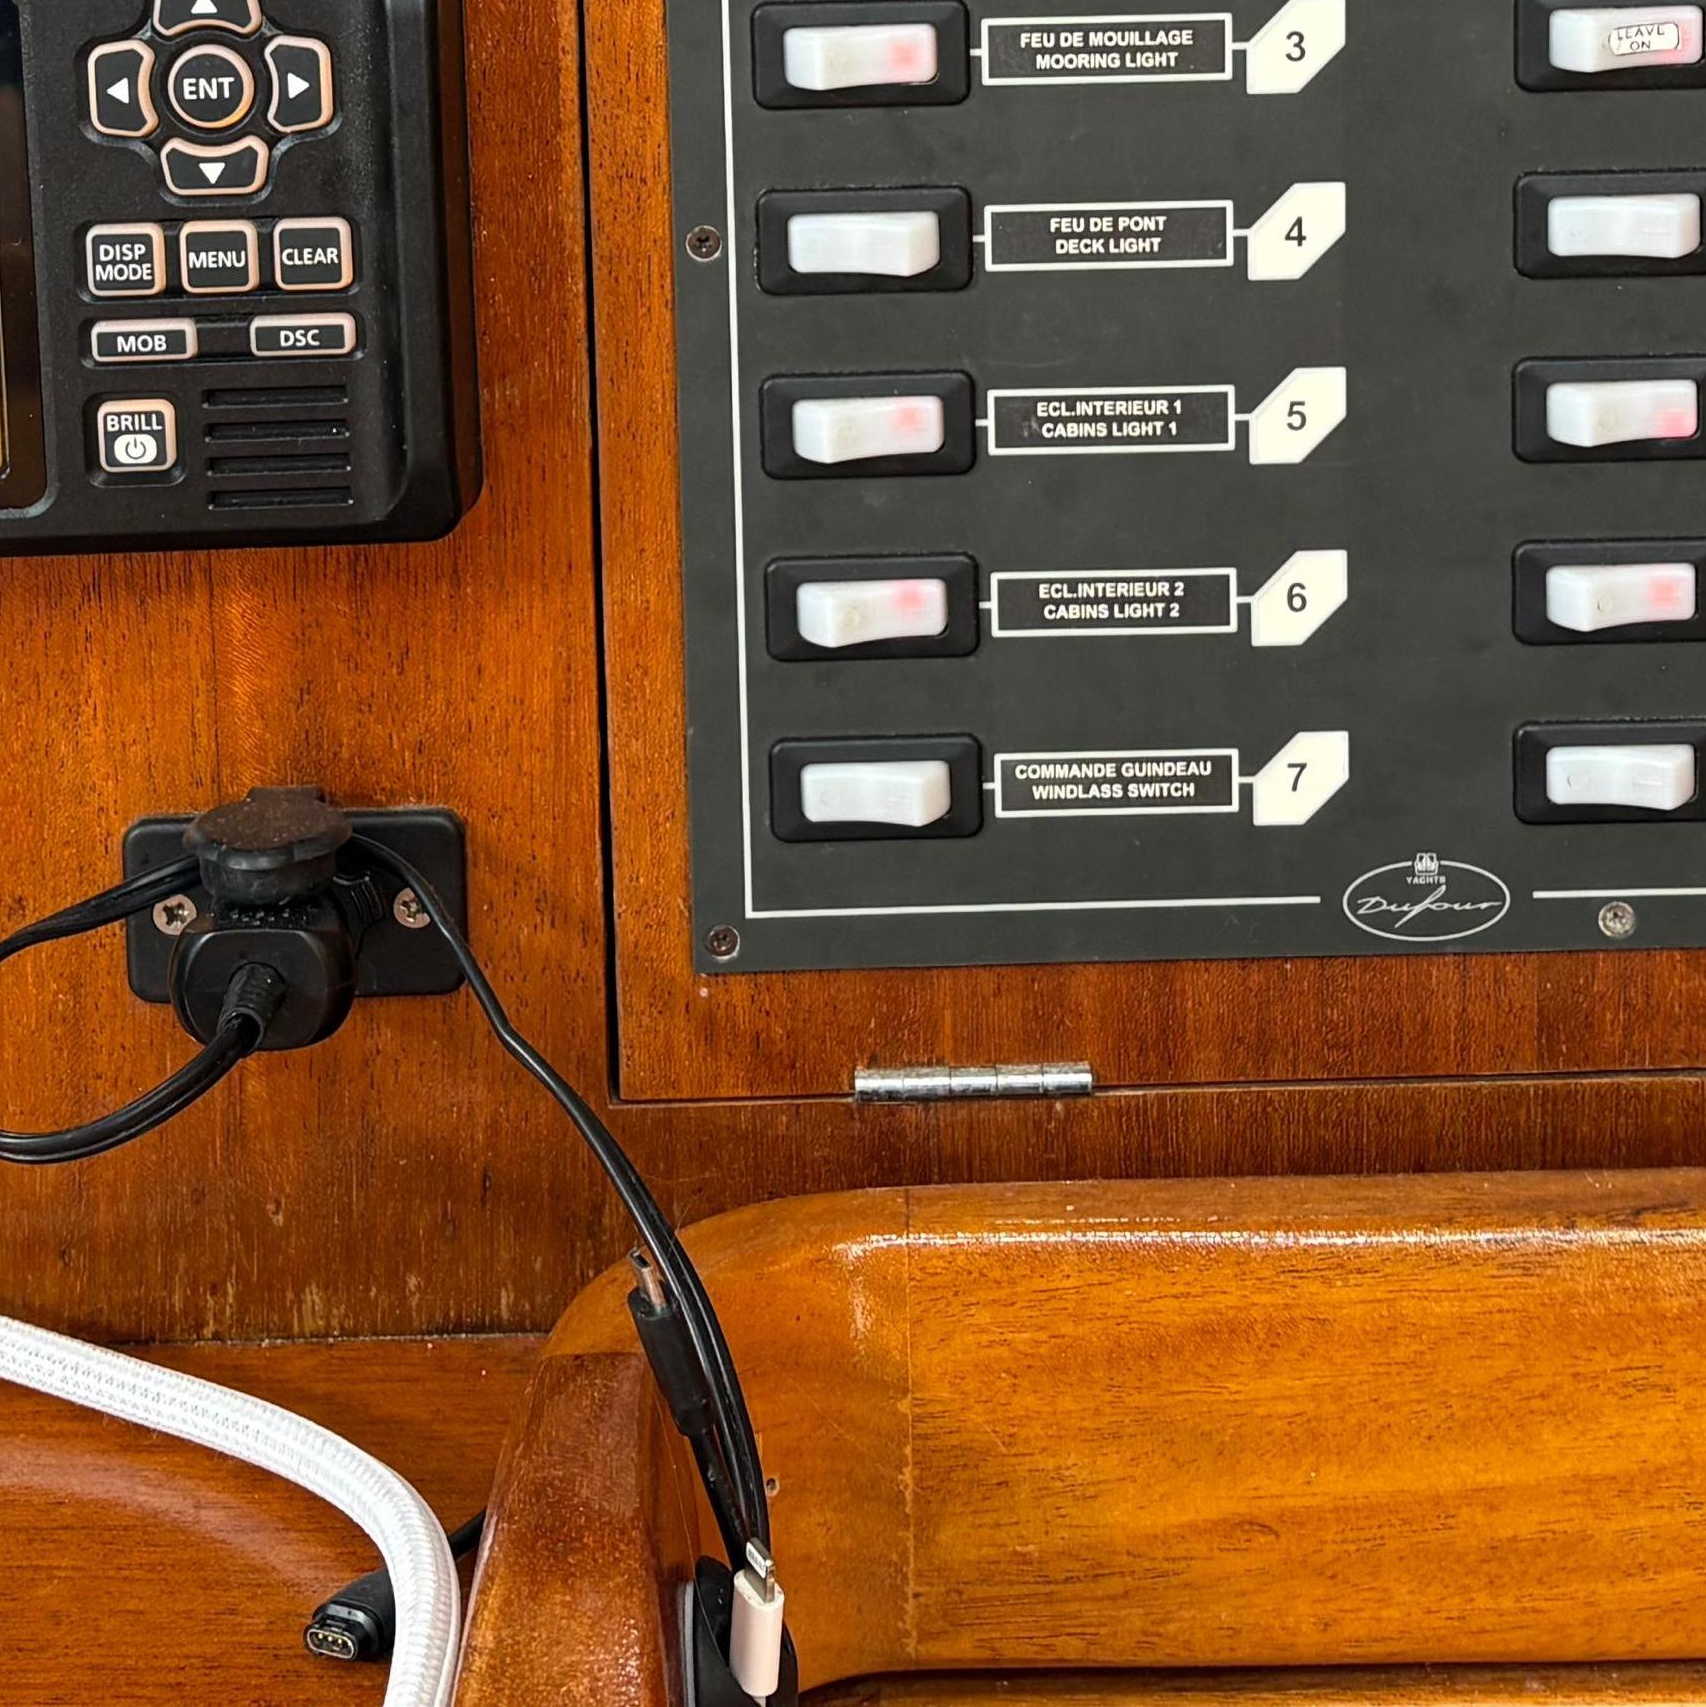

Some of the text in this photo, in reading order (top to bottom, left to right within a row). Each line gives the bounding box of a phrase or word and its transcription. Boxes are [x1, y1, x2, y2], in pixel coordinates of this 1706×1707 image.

[1019, 29, 1193, 48] FEU DE MOUILLAGE
[1284, 31, 1307, 61] 3
[183, 77, 235, 100] ENT
[1283, 216, 1307, 246] 4
[99, 244, 145, 262] DISP
[1055, 236, 1161, 255] DECK LIGHT
[189, 250, 245, 268] MENU
[282, 248, 339, 265] CLEAR
[95, 263, 153, 281] MODE
[117, 335, 167, 353] MOB
[280, 329, 320, 346] DSC
[107, 414, 162, 432] BRILL
[1285, 401, 1307, 431] 5
[1285, 582, 1308, 612] 6
[1015, 759, 1212, 779] COMMANDE GUINDEAU
[1287, 763, 1307, 792] 7
[1031, 781, 1195, 800] WINDLASS SWITCH
[1406, 876, 1446, 884] YACHTS
[1357, 884, 1502, 928] Dufour
